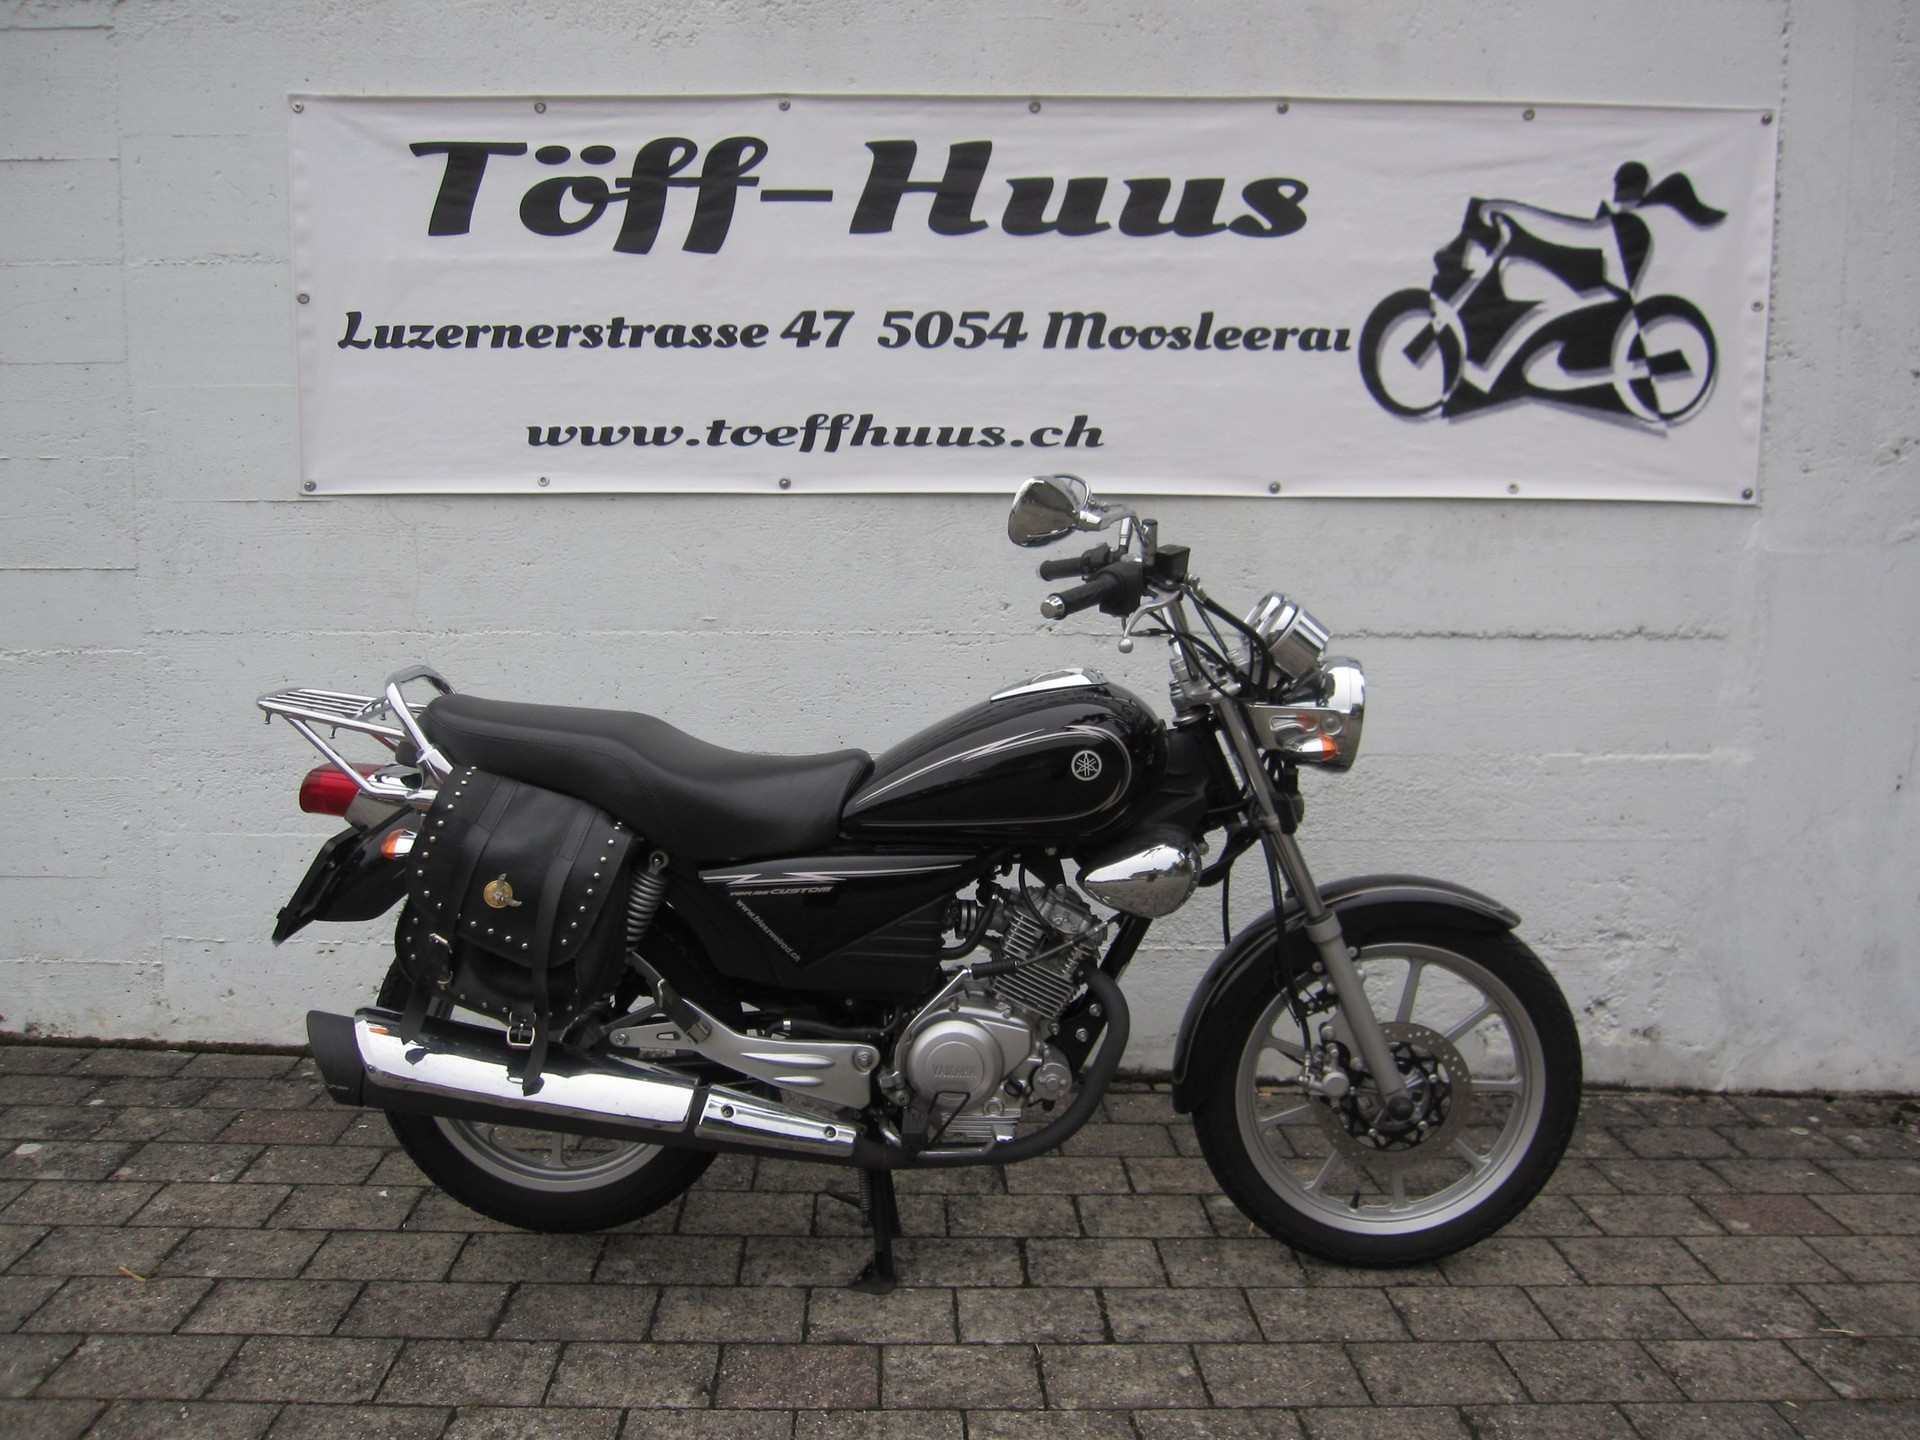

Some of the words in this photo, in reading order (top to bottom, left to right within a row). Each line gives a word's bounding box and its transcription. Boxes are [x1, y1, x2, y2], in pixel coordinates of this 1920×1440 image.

[408, 136, 1309, 255] Töff-Huus
[337, 311, 769, 350] Luzernerstrasse
[779, 310, 855, 348] 47
[877, 310, 1029, 349] 5054
[526, 413, 1104, 453] www.toeffhuus.ch
[769, 886, 834, 895] CUSTOM
[932, 1064, 977, 1078] YAMAHA
